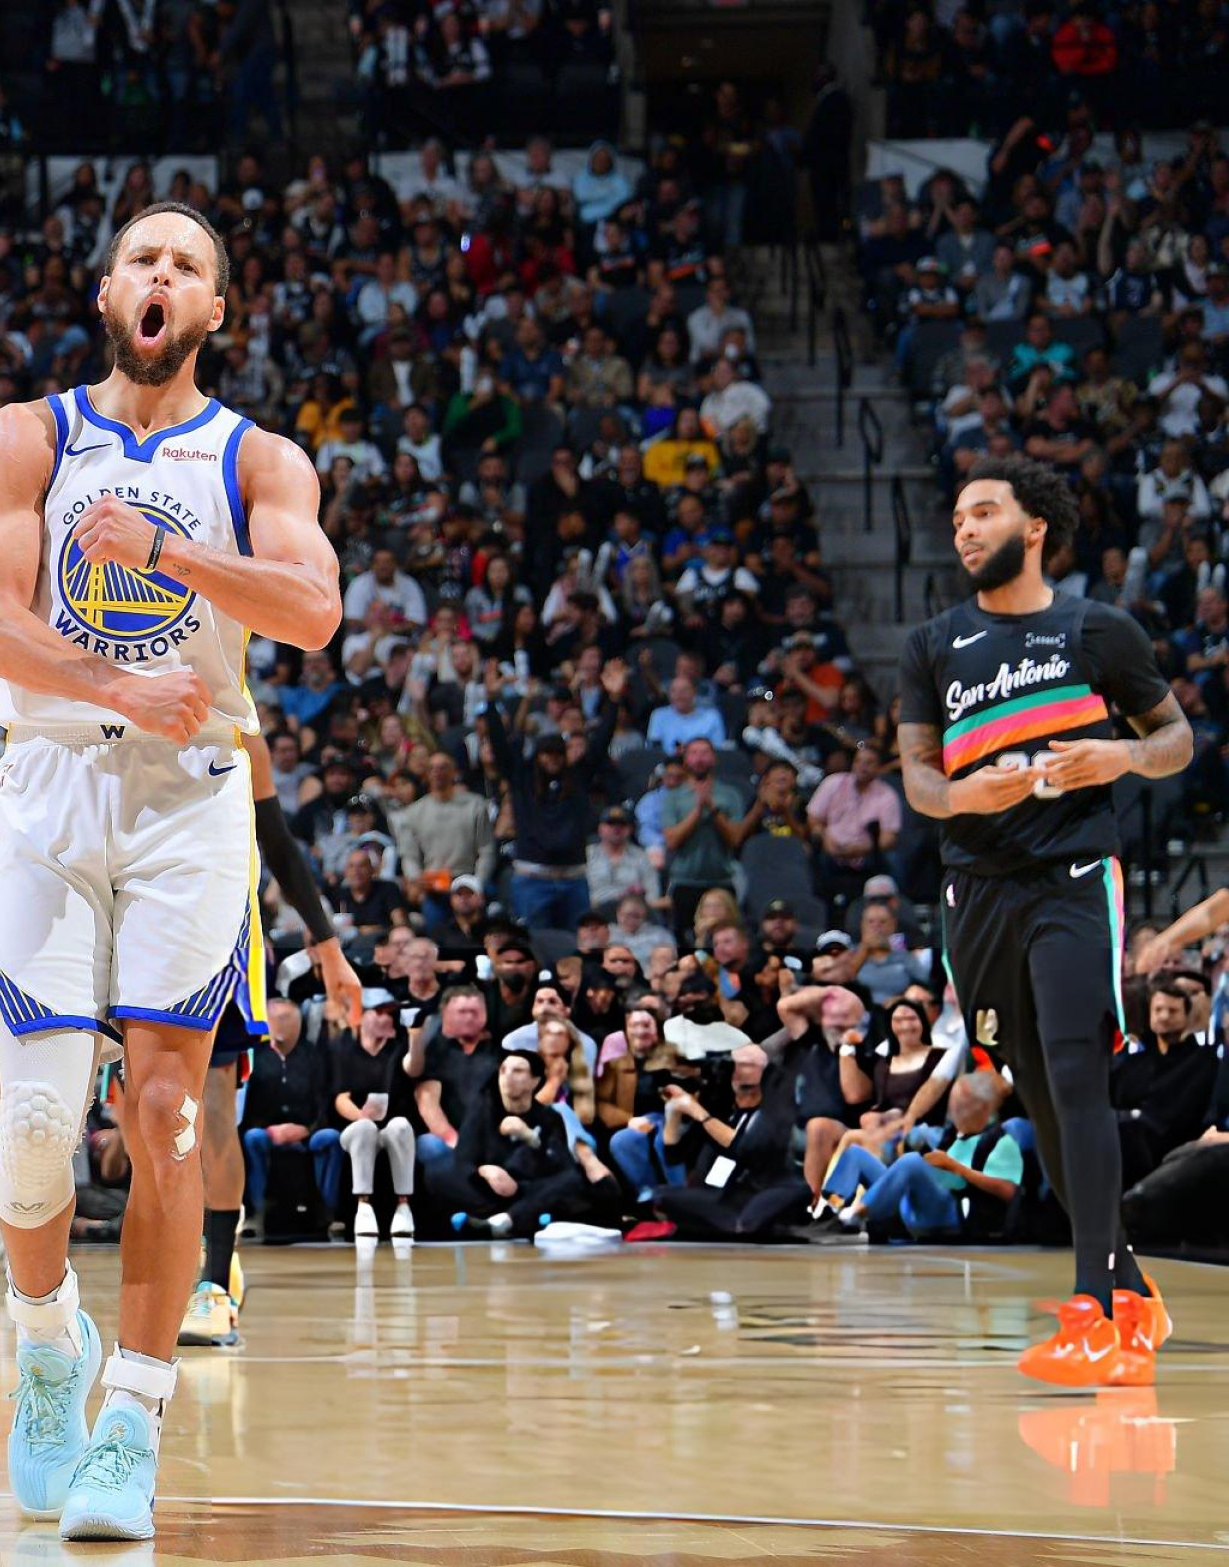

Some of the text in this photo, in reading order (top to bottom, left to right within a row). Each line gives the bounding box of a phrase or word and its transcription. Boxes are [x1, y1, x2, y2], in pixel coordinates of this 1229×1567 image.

[162, 447, 217, 461] Rakuten
[150, 491, 201, 530] STATE
[55, 608, 200, 661] WARRIORS
[946, 653, 1070, 721] San Antonio
[100, 724, 126, 740] W
